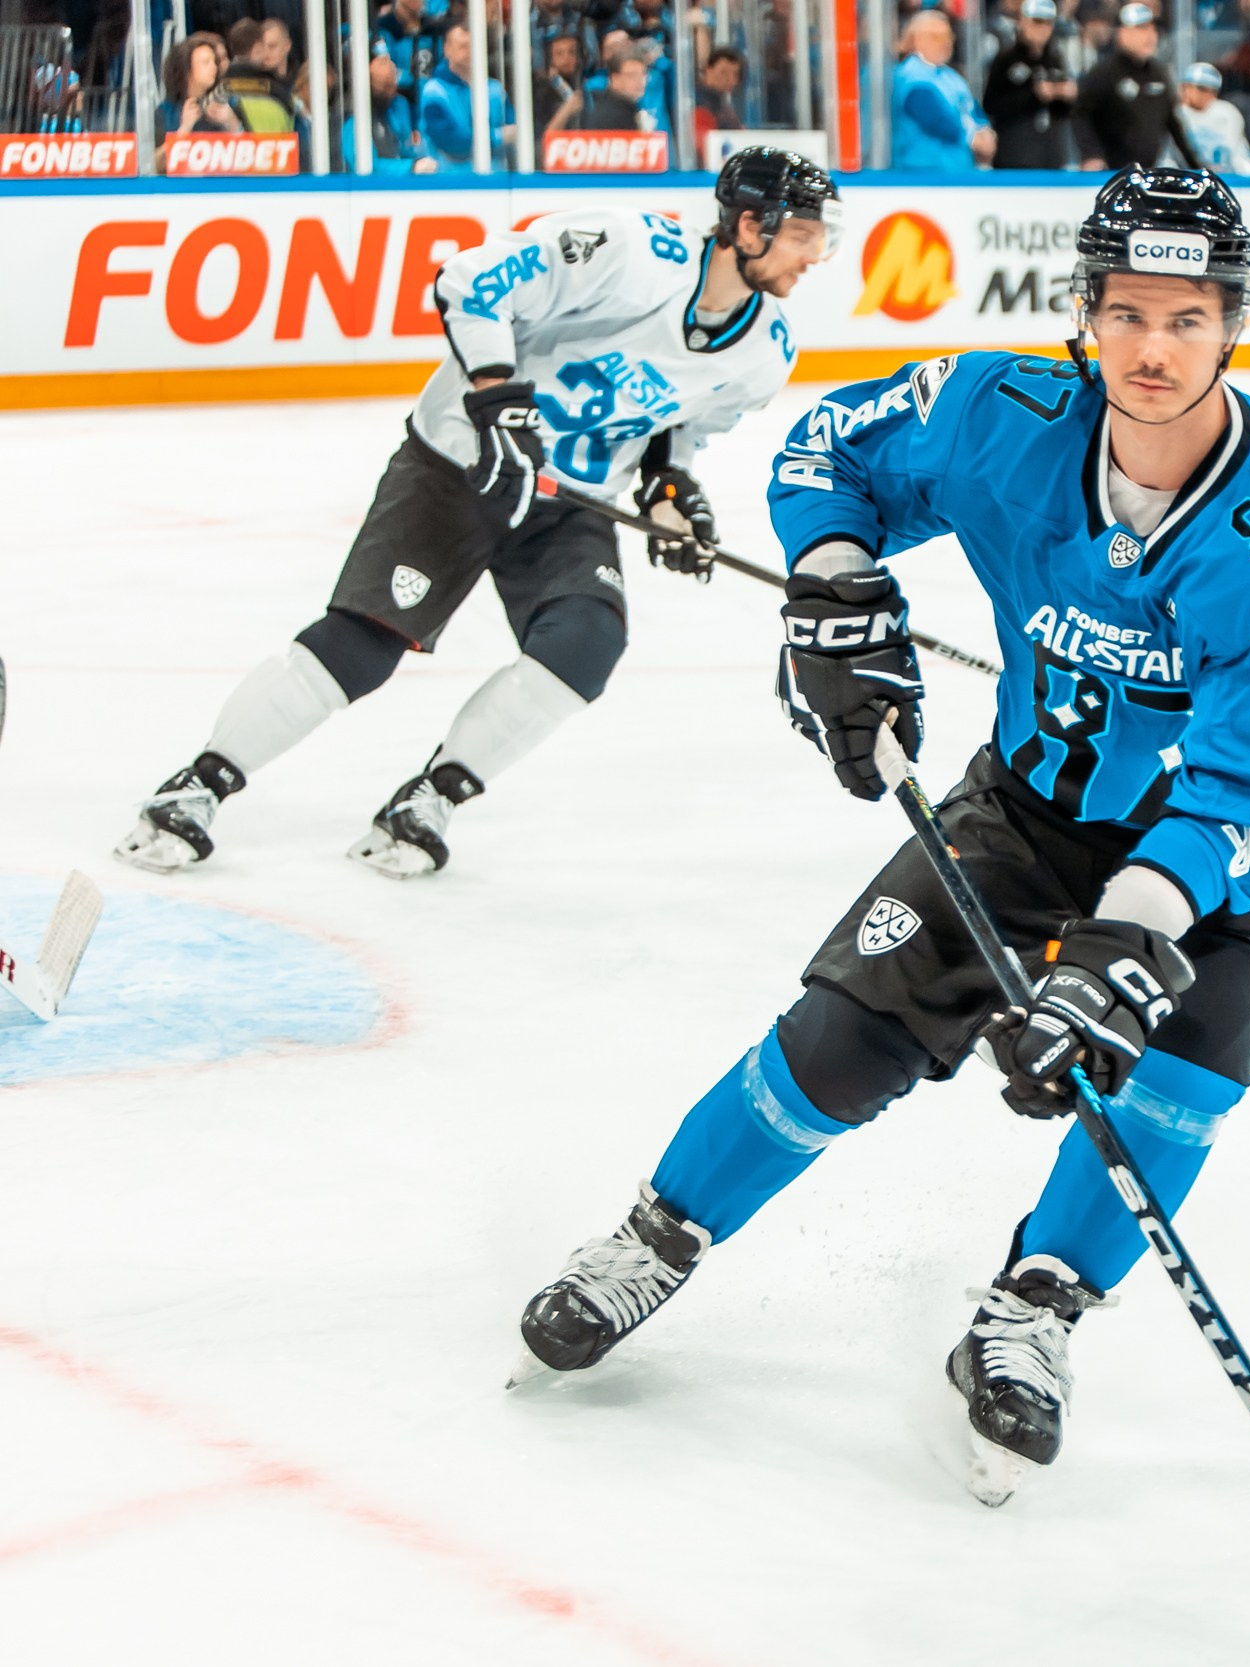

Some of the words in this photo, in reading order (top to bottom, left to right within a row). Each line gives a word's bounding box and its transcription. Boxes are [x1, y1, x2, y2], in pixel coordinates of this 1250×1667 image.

[1, 141, 134, 174] FONBET
[168, 140, 297, 172] FONBET
[547, 137, 666, 168] FONBET
[769, 318, 797, 364] 2
[785, 611, 910, 648] CCM
[1066, 605, 1153, 646] FONBET
